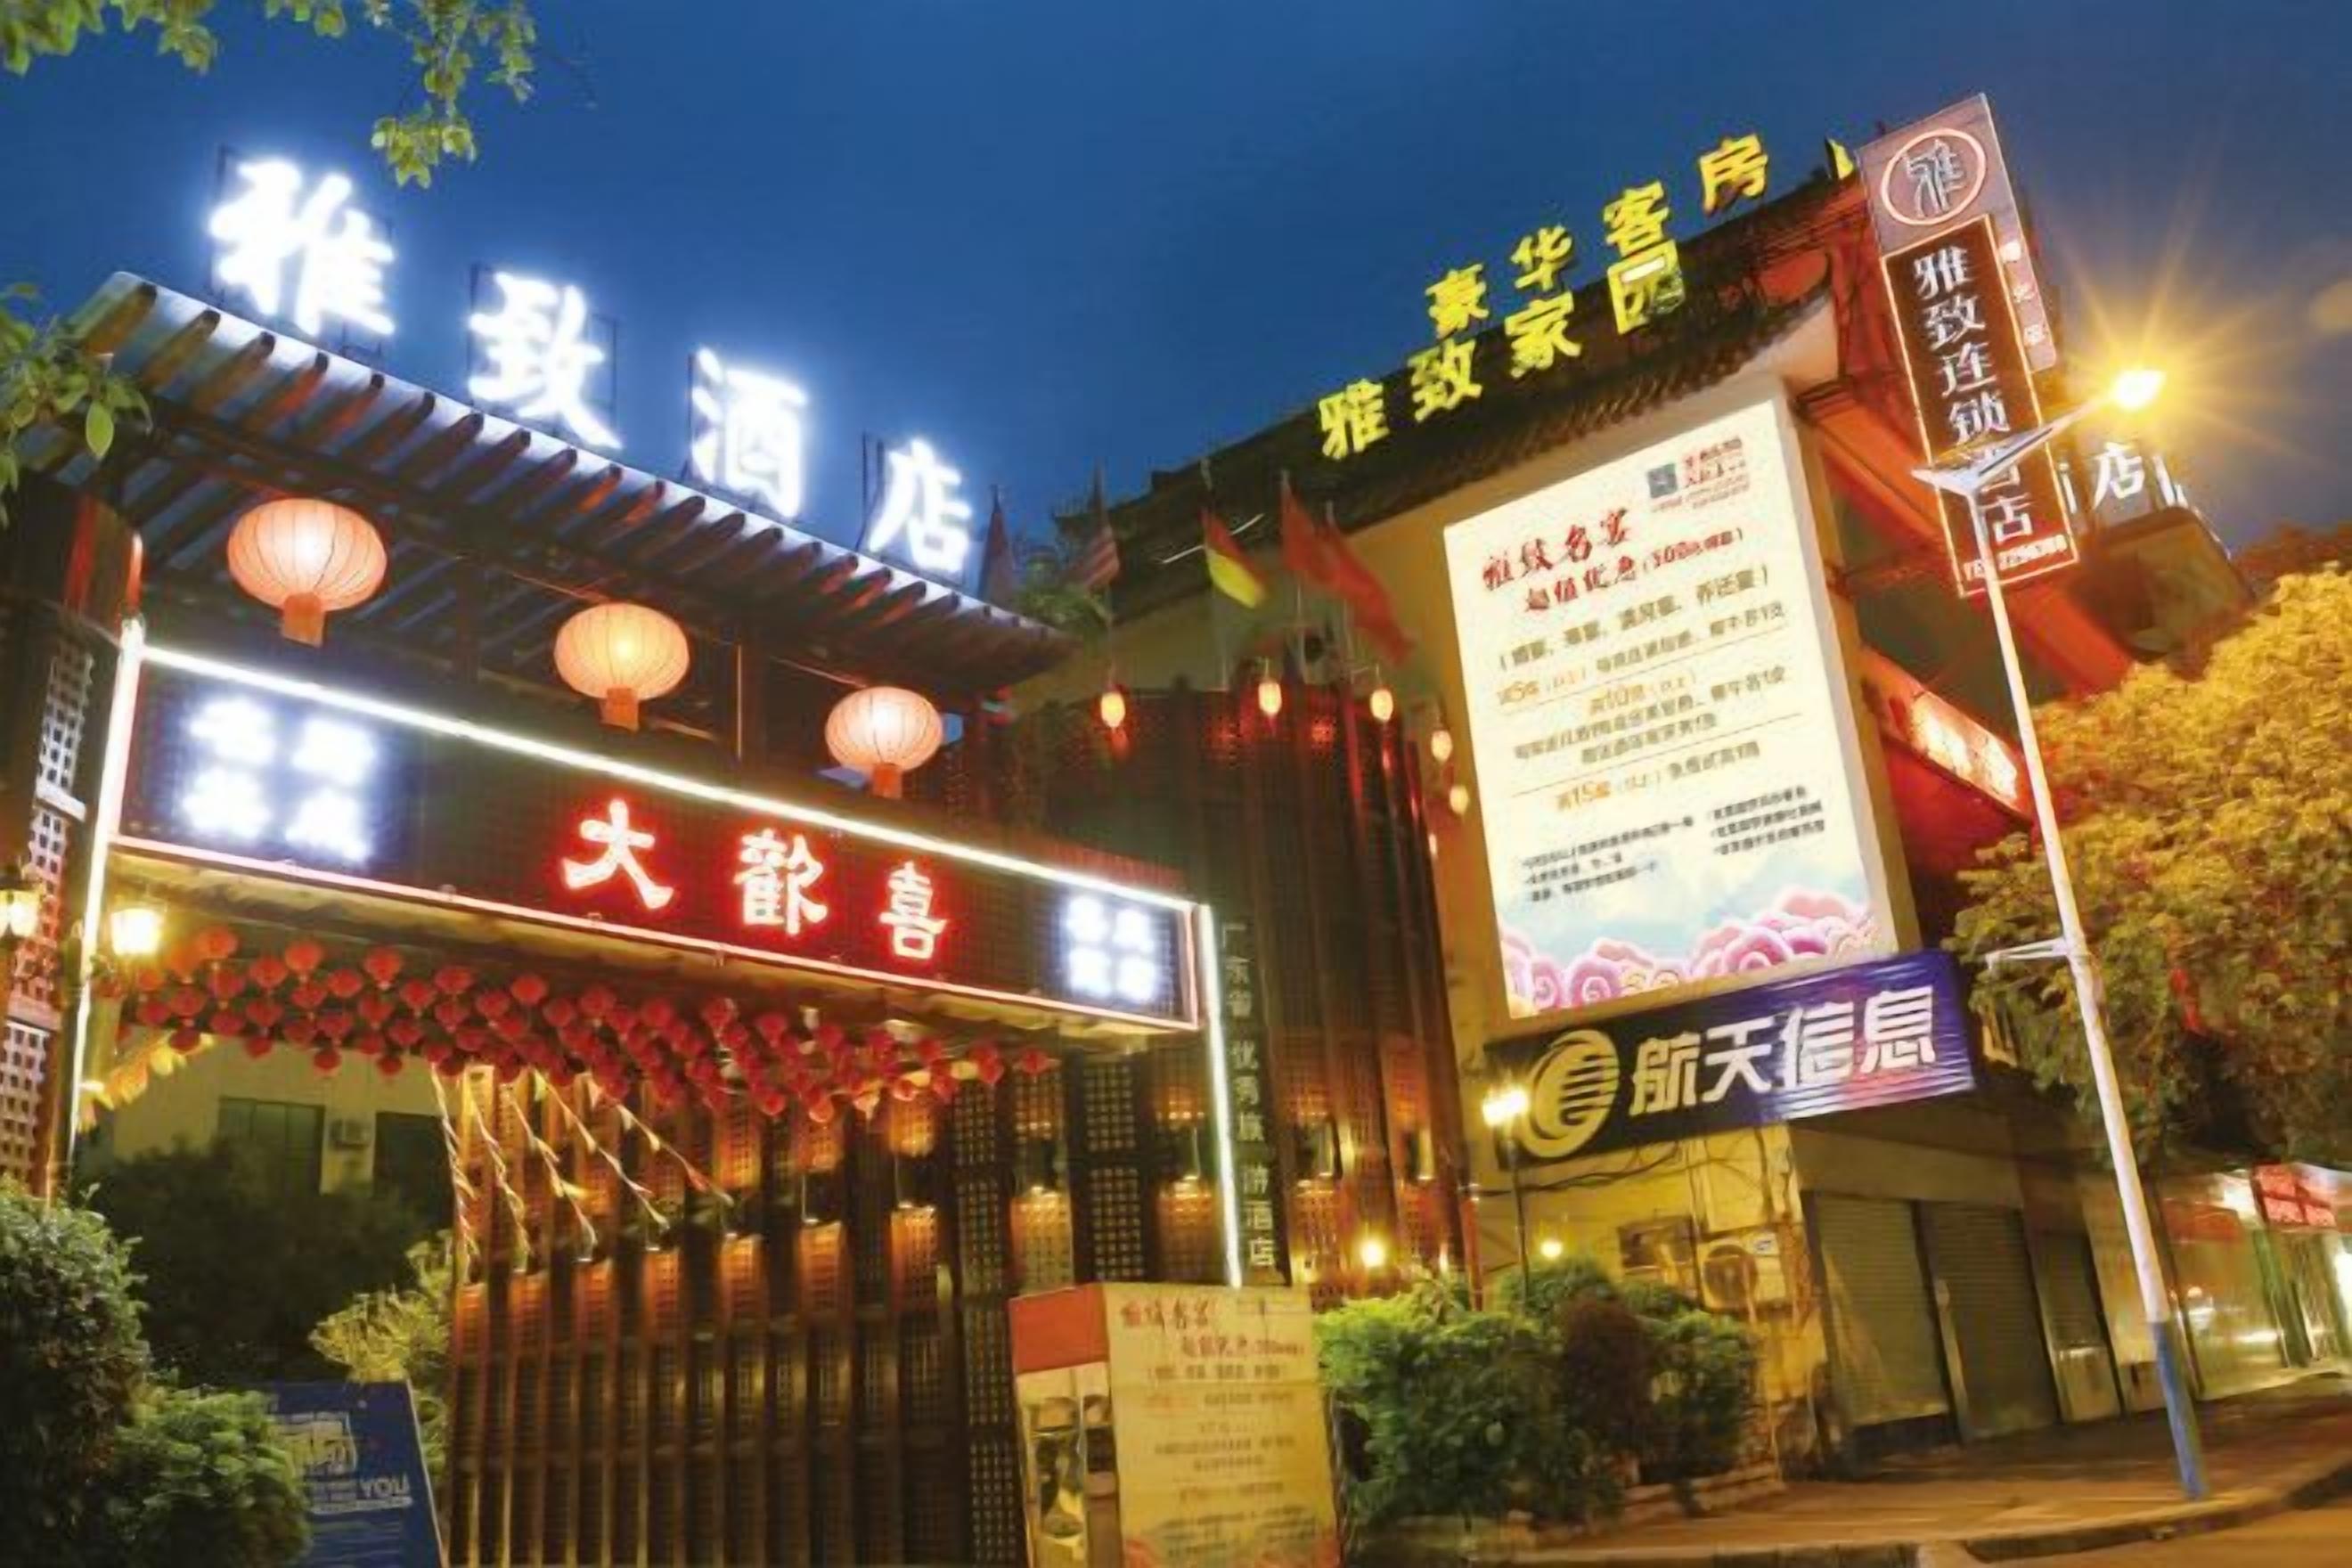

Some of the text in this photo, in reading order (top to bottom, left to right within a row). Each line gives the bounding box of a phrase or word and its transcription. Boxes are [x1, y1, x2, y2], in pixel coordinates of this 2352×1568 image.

[1425, 134, 1854, 338] 豪华客房
[210, 158, 972, 574] 雅致酒店
[1319, 240, 1686, 460] 雅致家园
[1915, 246, 2033, 543] 雅致连锁店
[1629, 985, 1936, 1116] 航天信息
